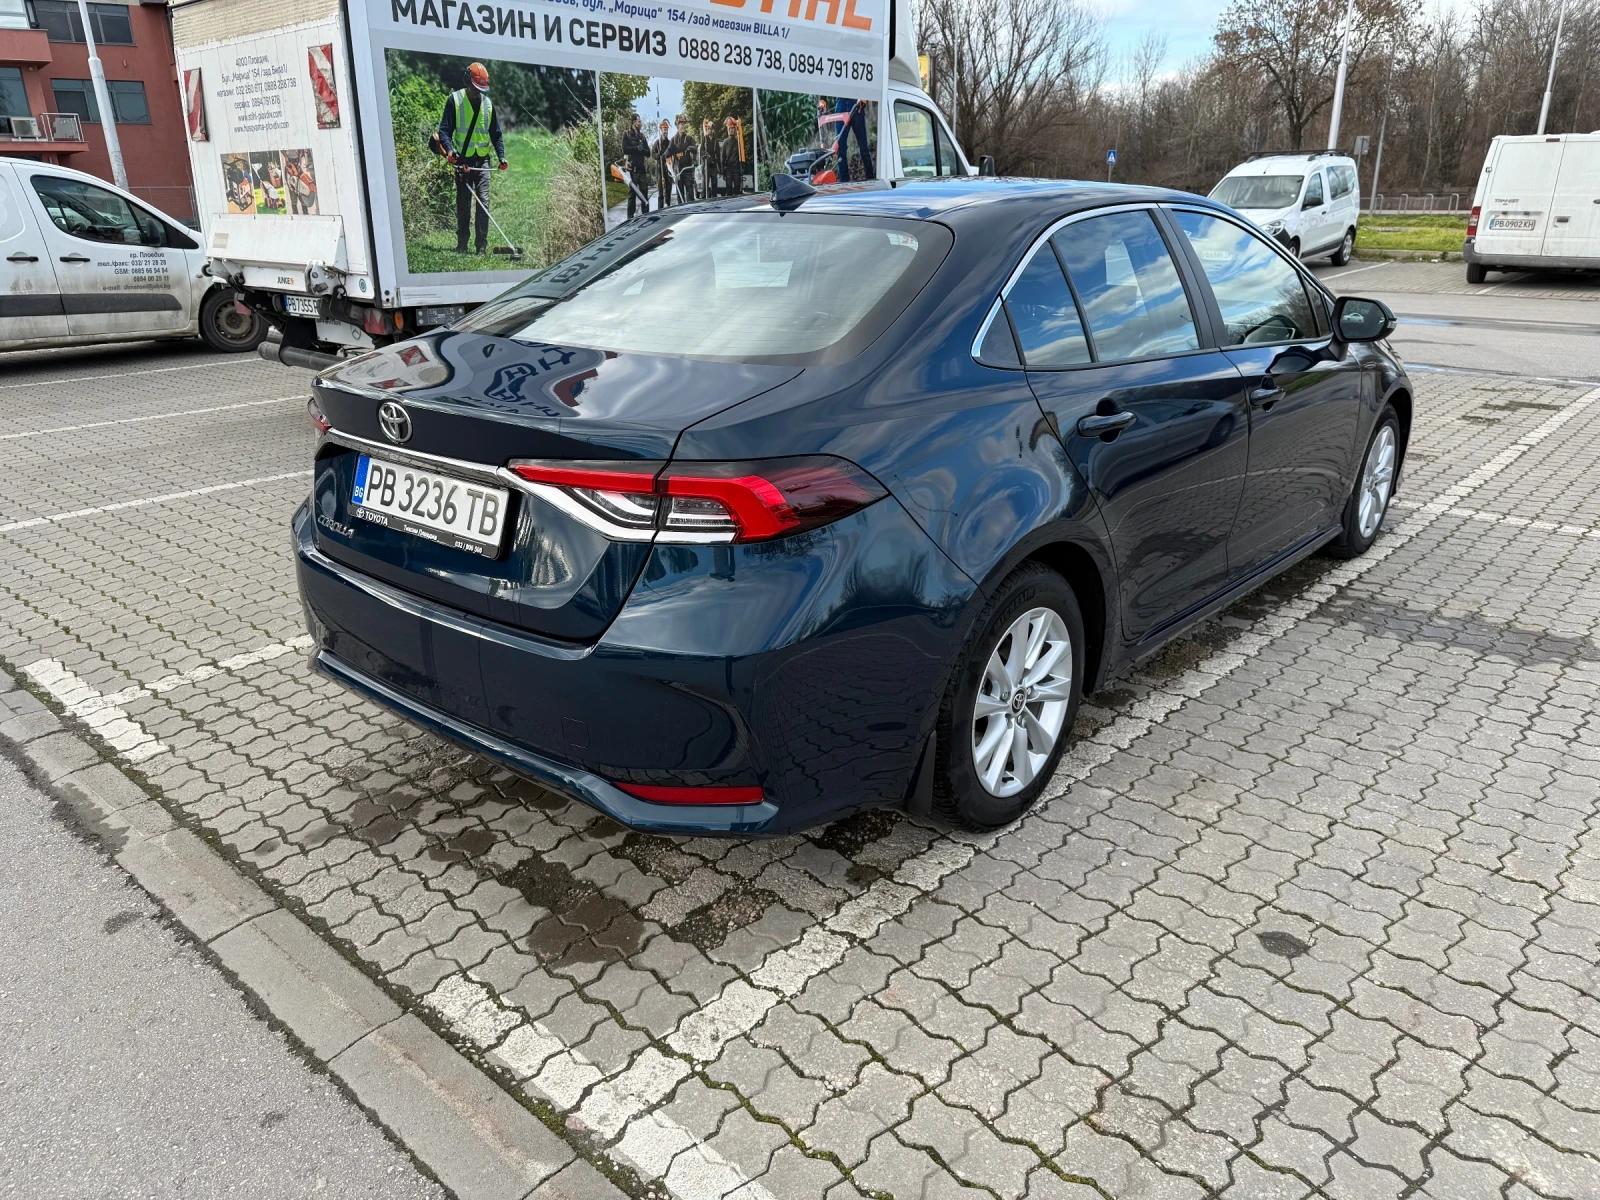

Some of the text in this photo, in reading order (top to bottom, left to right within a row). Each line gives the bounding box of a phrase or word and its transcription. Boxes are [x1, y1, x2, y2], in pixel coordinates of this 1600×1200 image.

[391, 0, 667, 57] МАГАЗИН И СЕРВИЗ
[667, 9, 686, 23] 154
[688, 12, 711, 27] /зад
[712, 18, 751, 33] магазин
[753, 22, 780, 37] BILLA
[781, 27, 791, 39] 1/
[678, 37, 874, 82] 0888 238 738, 0894 791 878
[235, 85, 245, 96] 032
[245, 84, 254, 95] 260
[264, 81, 278, 92] 0888
[286, 78, 297, 88] 738
[1494, 220, 1535, 228] PB 0902 KH
[354, 486, 364, 498] BG
[366, 464, 500, 536] PB 3236 TB
[317, 514, 356, 539] COROLLA
[365, 511, 388, 526] TOYOTA
